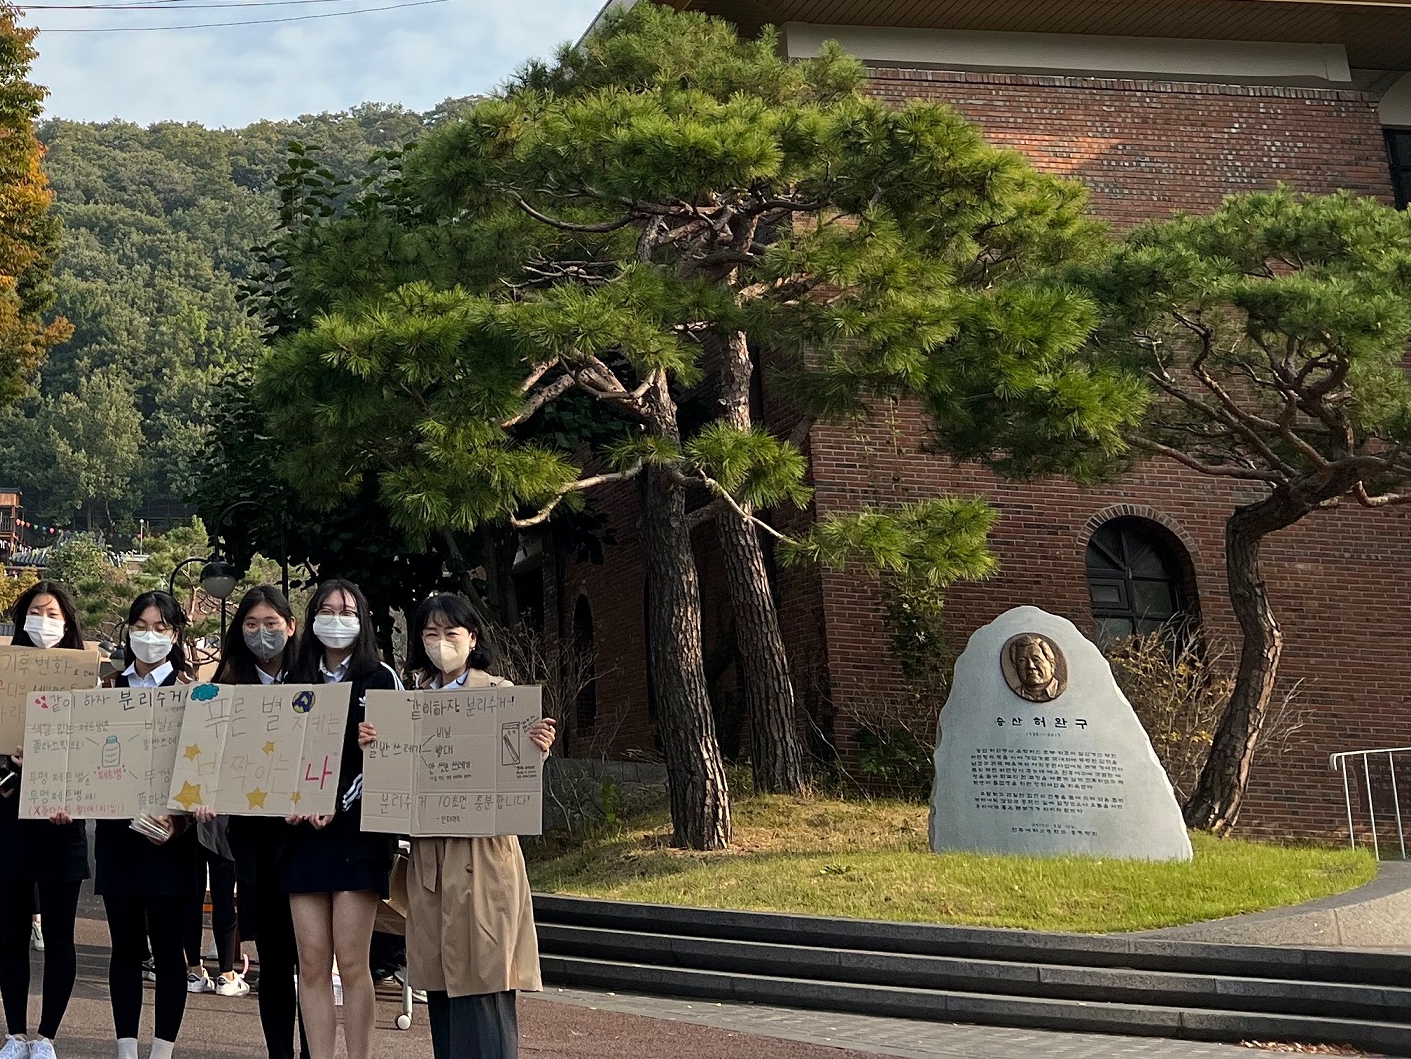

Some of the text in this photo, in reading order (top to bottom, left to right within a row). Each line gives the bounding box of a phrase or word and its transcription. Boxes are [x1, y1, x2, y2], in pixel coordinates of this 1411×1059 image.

[50, 695, 76, 712] 같이
[84, 695, 110, 706] 하자
[202, 694, 340, 739] 푸른 별 지키는
[437, 726, 451, 738] 비닐
[196, 751, 289, 794] 반짝이는
[29, 790, 49, 804] 투명
[380, 793, 427, 813] 분리수거
